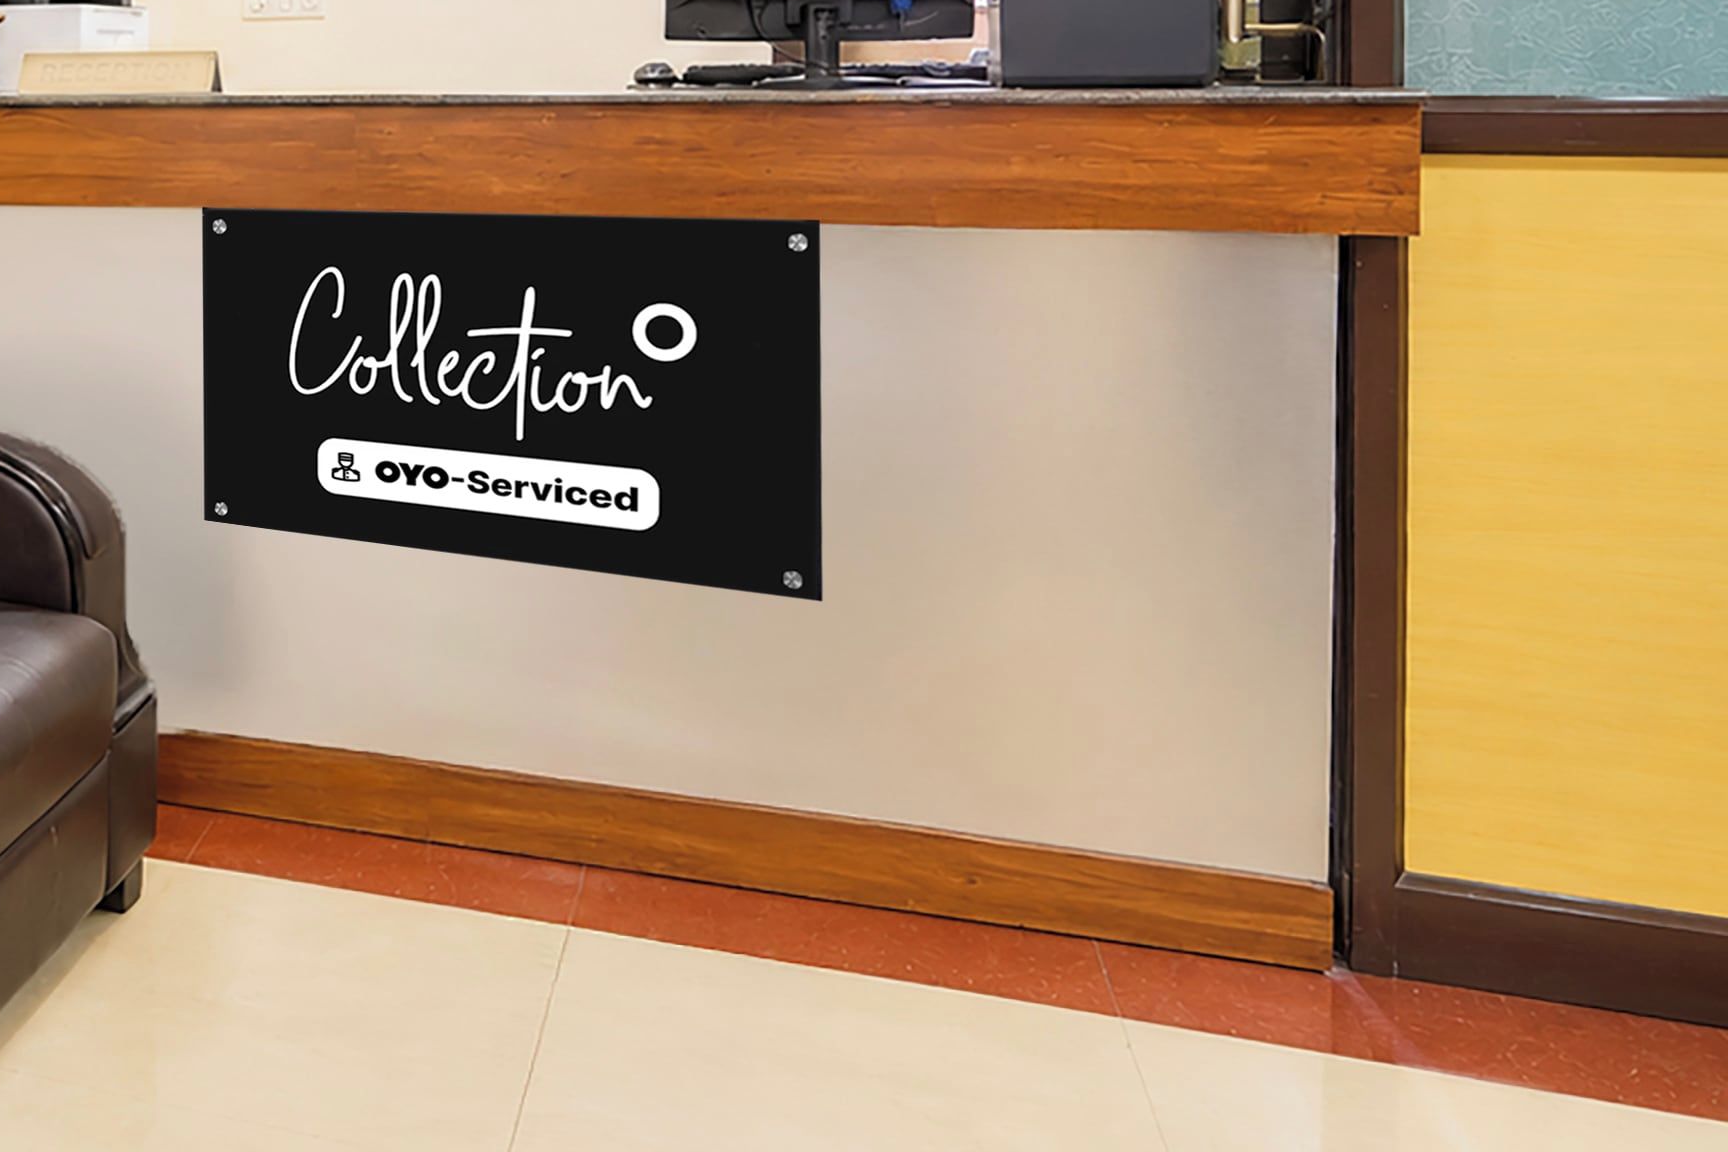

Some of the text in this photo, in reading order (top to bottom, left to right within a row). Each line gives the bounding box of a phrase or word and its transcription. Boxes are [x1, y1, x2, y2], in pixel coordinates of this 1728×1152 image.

[39, 62, 192, 83] RECEPTION
[289, 267, 652, 440] Collection
[375, 461, 639, 512] OYO-Serviced
